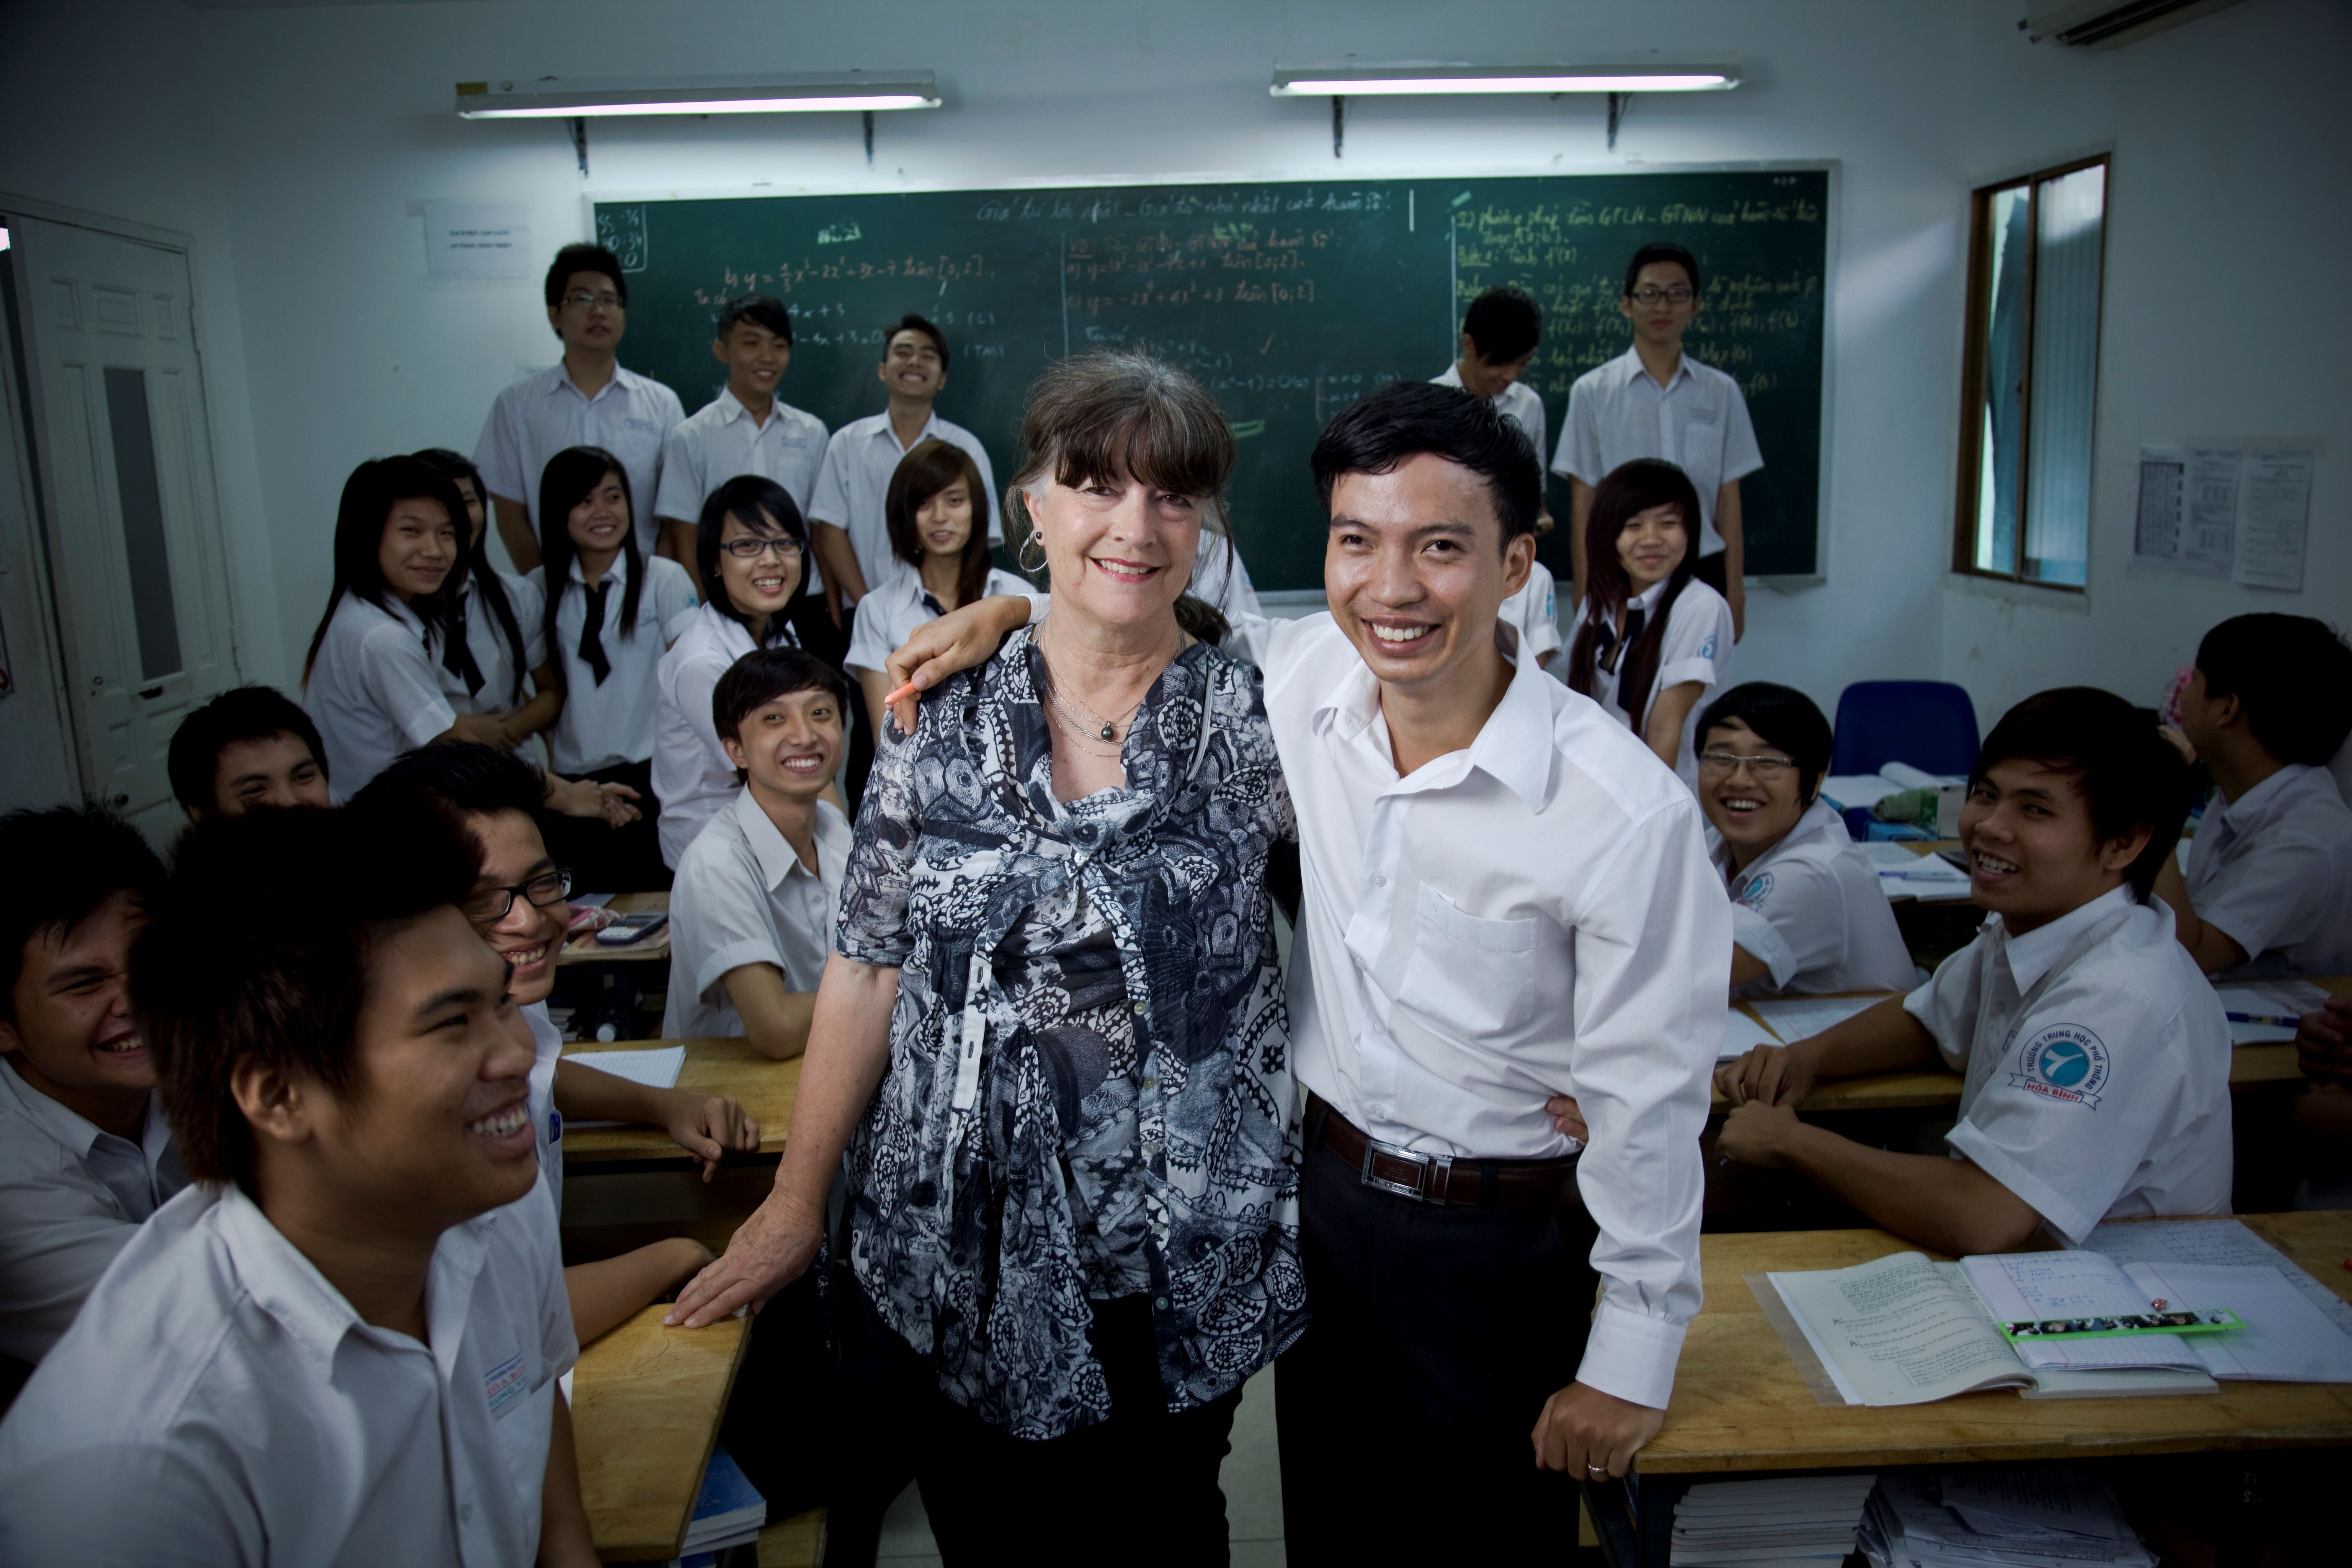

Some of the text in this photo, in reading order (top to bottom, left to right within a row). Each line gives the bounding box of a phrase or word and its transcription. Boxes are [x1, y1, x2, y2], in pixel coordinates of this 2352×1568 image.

[2027, 1029, 2105, 1090] TRƯỜNG TRUNG HỌC PHỔ THÔNG
[2027, 1082, 2079, 1101] HÒA BÌNH
